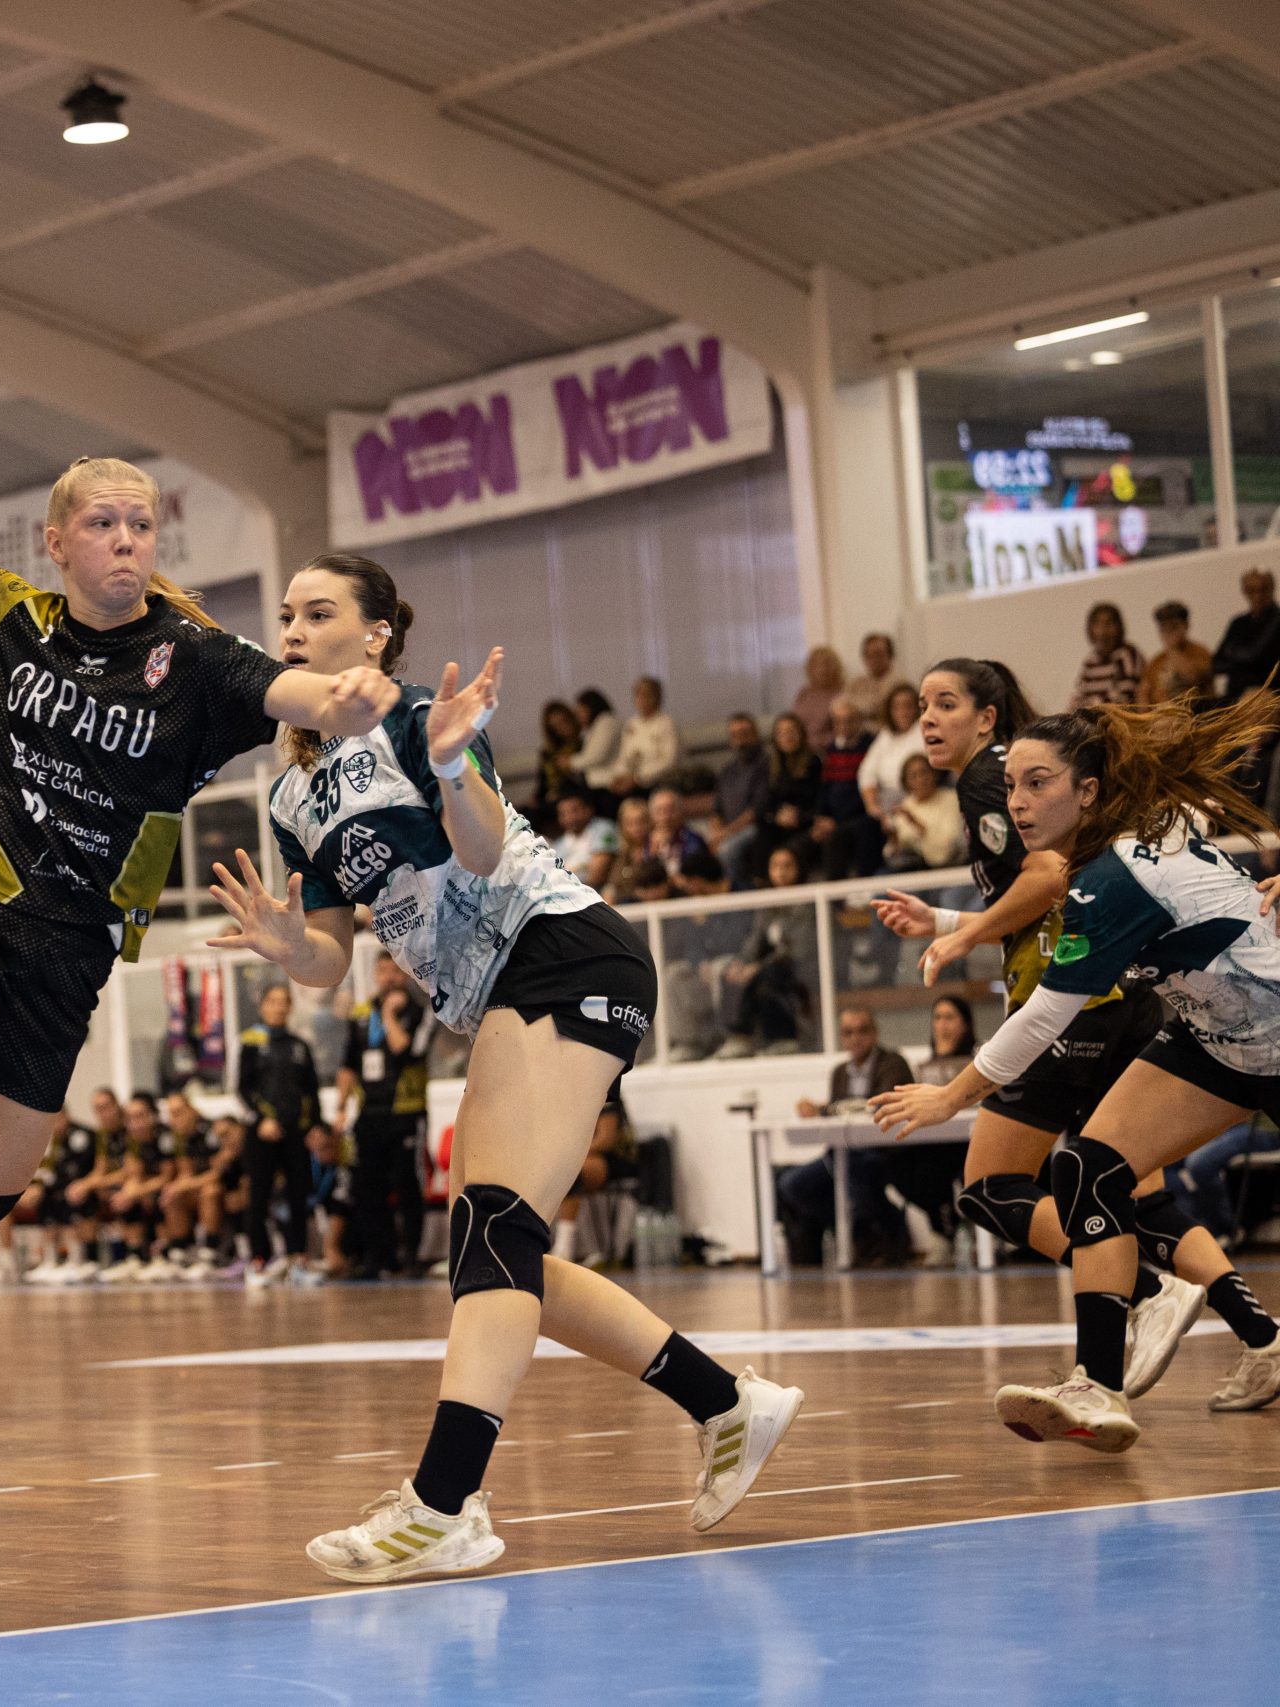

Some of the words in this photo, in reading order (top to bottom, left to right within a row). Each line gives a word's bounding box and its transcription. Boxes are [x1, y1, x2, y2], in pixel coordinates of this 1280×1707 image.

[553, 336, 731, 481] NON
[352, 393, 519, 523] NON
[7, 662, 157, 758] ORPAGU
[28, 750, 82, 782] XUNTA
[50, 775, 115, 810] GALICIA
[310, 757, 342, 827] 33
